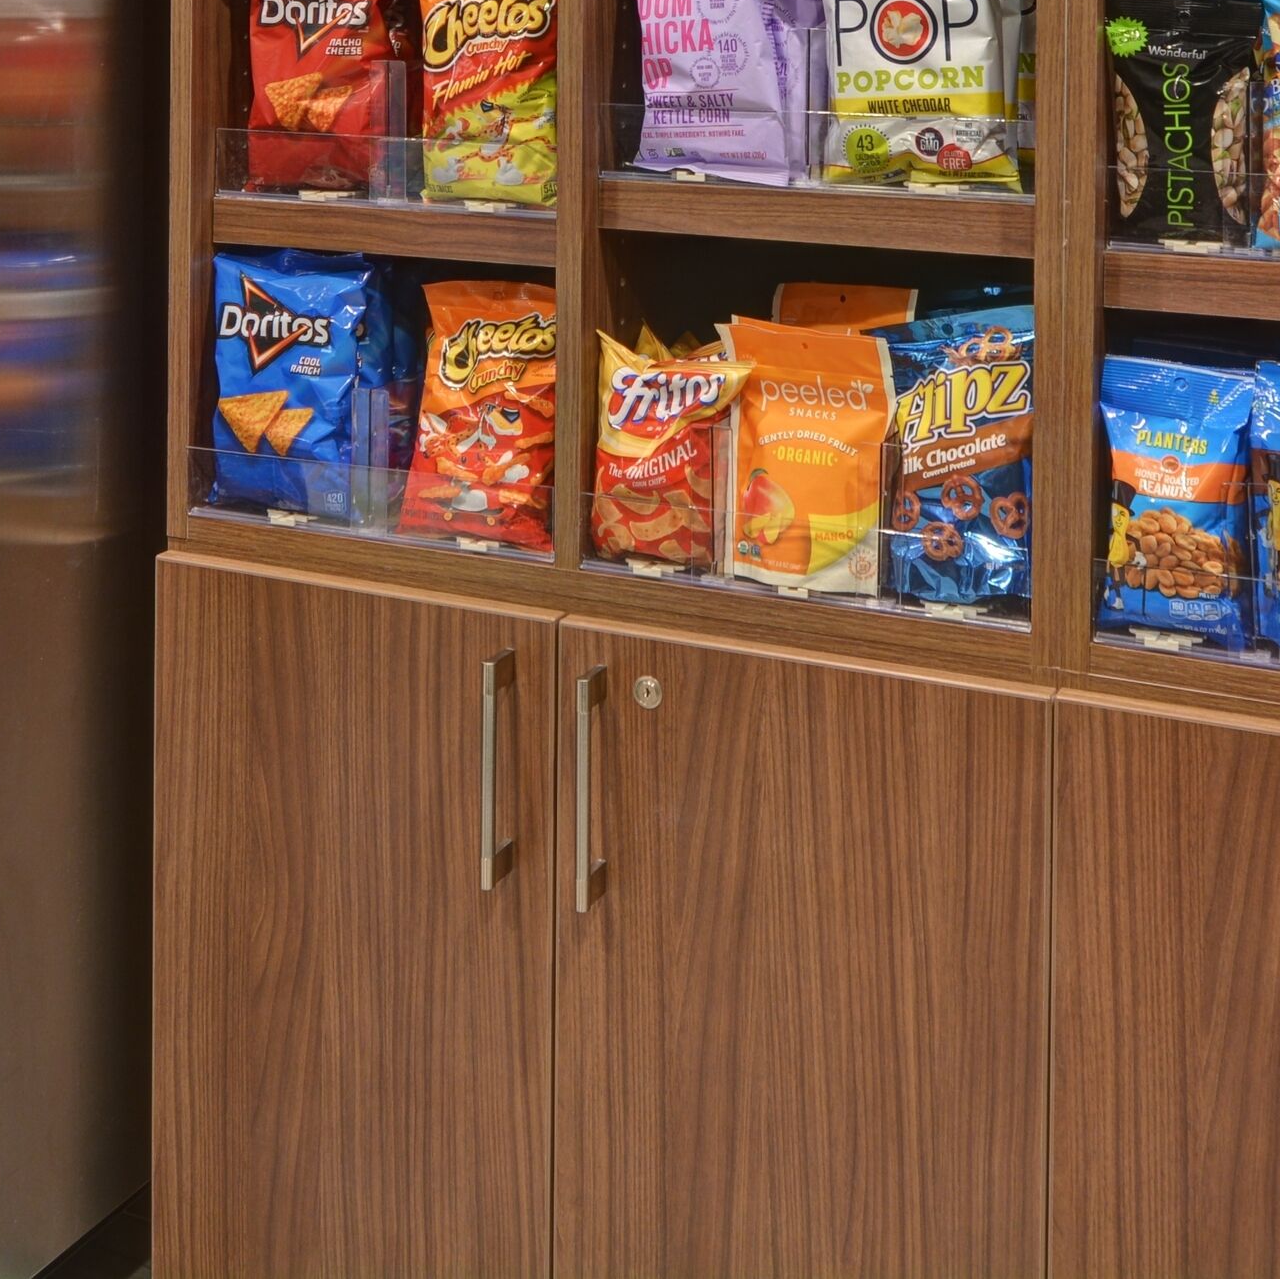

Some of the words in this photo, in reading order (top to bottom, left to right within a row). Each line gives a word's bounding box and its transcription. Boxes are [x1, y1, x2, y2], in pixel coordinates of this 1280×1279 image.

[329, 38, 362, 46] NACHO
[466, 39, 508, 56] Crunchy
[325, 46, 362, 56] CHEESE
[1148, 45, 1207, 60] Wonderful
[836, 66, 984, 93] POPCORN
[646, 94, 684, 109] SWEET
[687, 95, 696, 108] &
[699, 93, 734, 108] SALTY
[868, 100, 900, 114] WHITE
[902, 97, 951, 113] CHEDDAR
[653, 109, 695, 125] KETTLE
[698, 109, 730, 123] CORN
[1162, 62, 1194, 227] PISTACHIOS
[220, 306, 330, 344] Doritos
[471, 361, 524, 395] Crunchy
[789, 406, 837, 421] SNACKS
[759, 430, 795, 445] GENTLY
[796, 430, 826, 443] DRIED
[827, 435, 858, 457] FRUIT
[1136, 430, 1209, 455] PLANTERS
